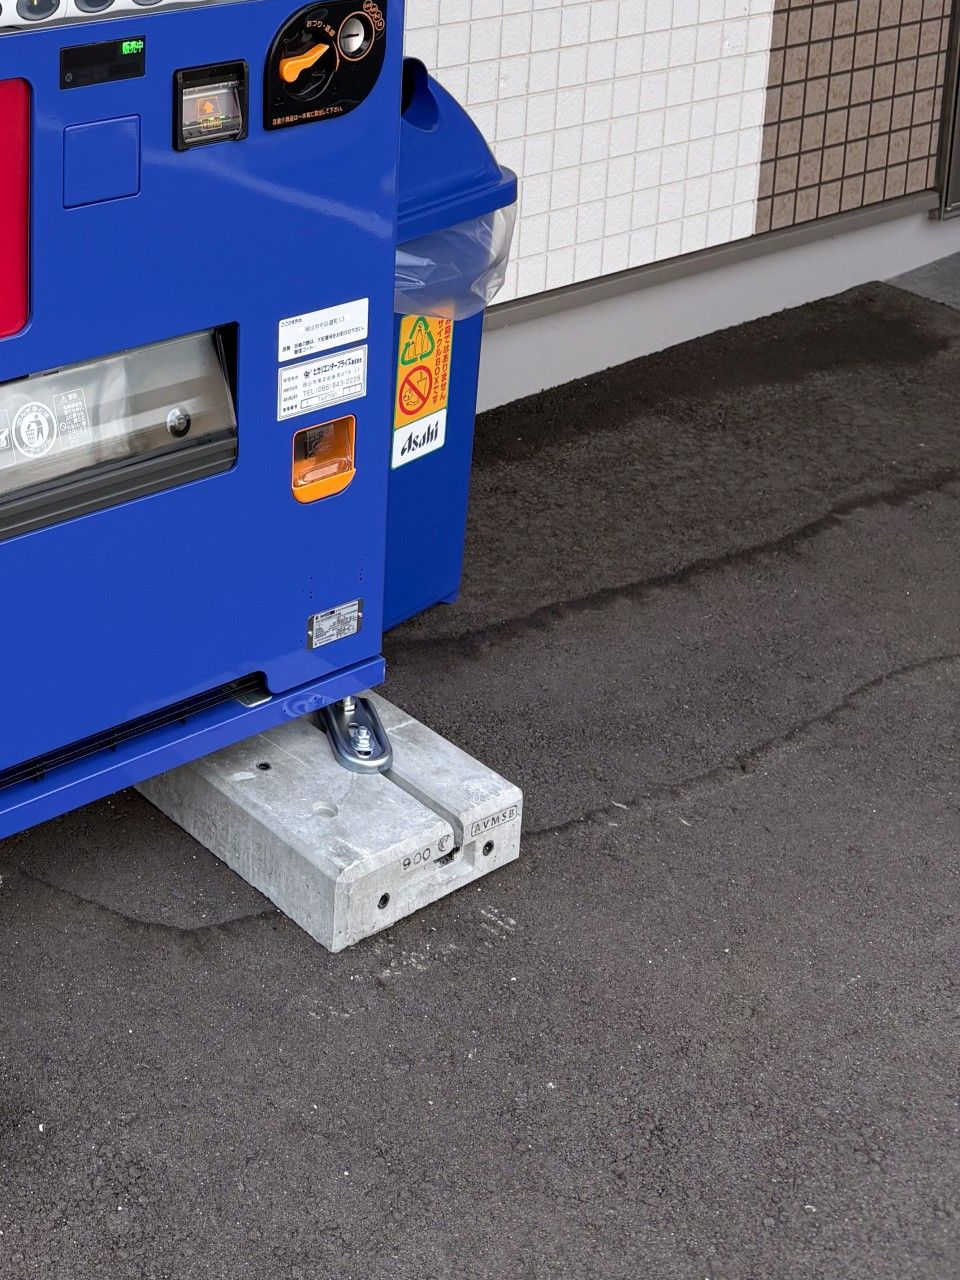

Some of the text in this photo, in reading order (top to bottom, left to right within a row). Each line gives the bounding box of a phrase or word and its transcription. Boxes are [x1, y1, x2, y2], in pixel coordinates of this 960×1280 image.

[401, 420, 439, 457] Asahi
[473, 808, 515, 834] AVMSB
[402, 847, 431, 870] 900
